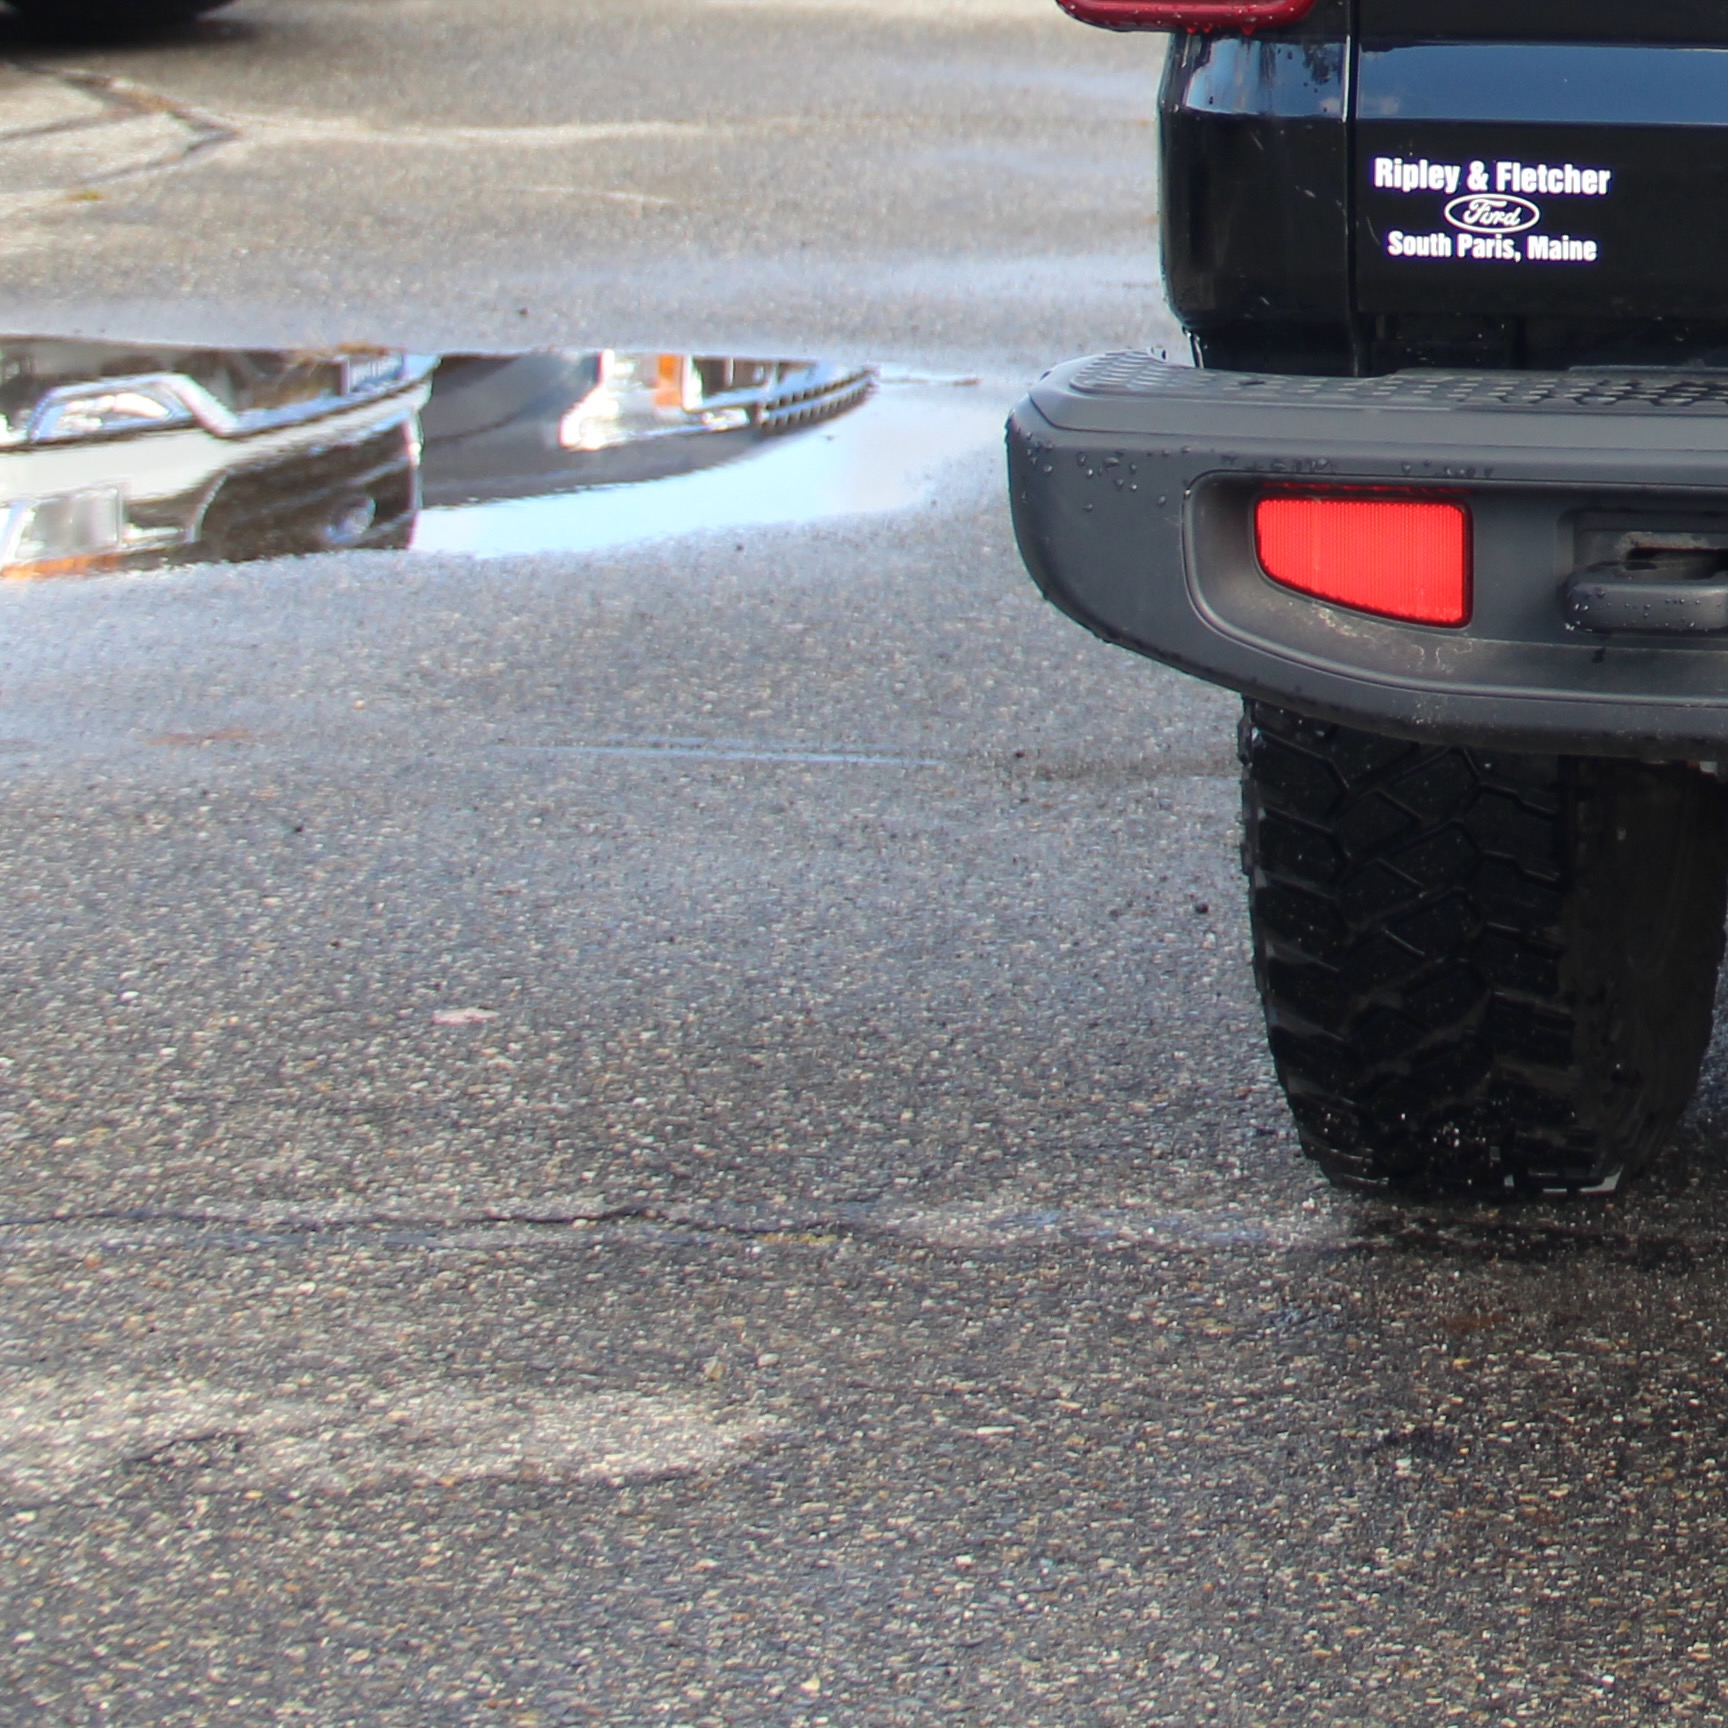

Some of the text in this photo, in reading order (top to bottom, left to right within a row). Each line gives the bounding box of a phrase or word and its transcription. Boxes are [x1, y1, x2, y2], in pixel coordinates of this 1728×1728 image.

[1374, 157, 1611, 194] Ripley & Fletcher
[1463, 197, 1522, 226] Ford
[1388, 230, 1598, 263] South Paris, Maine
